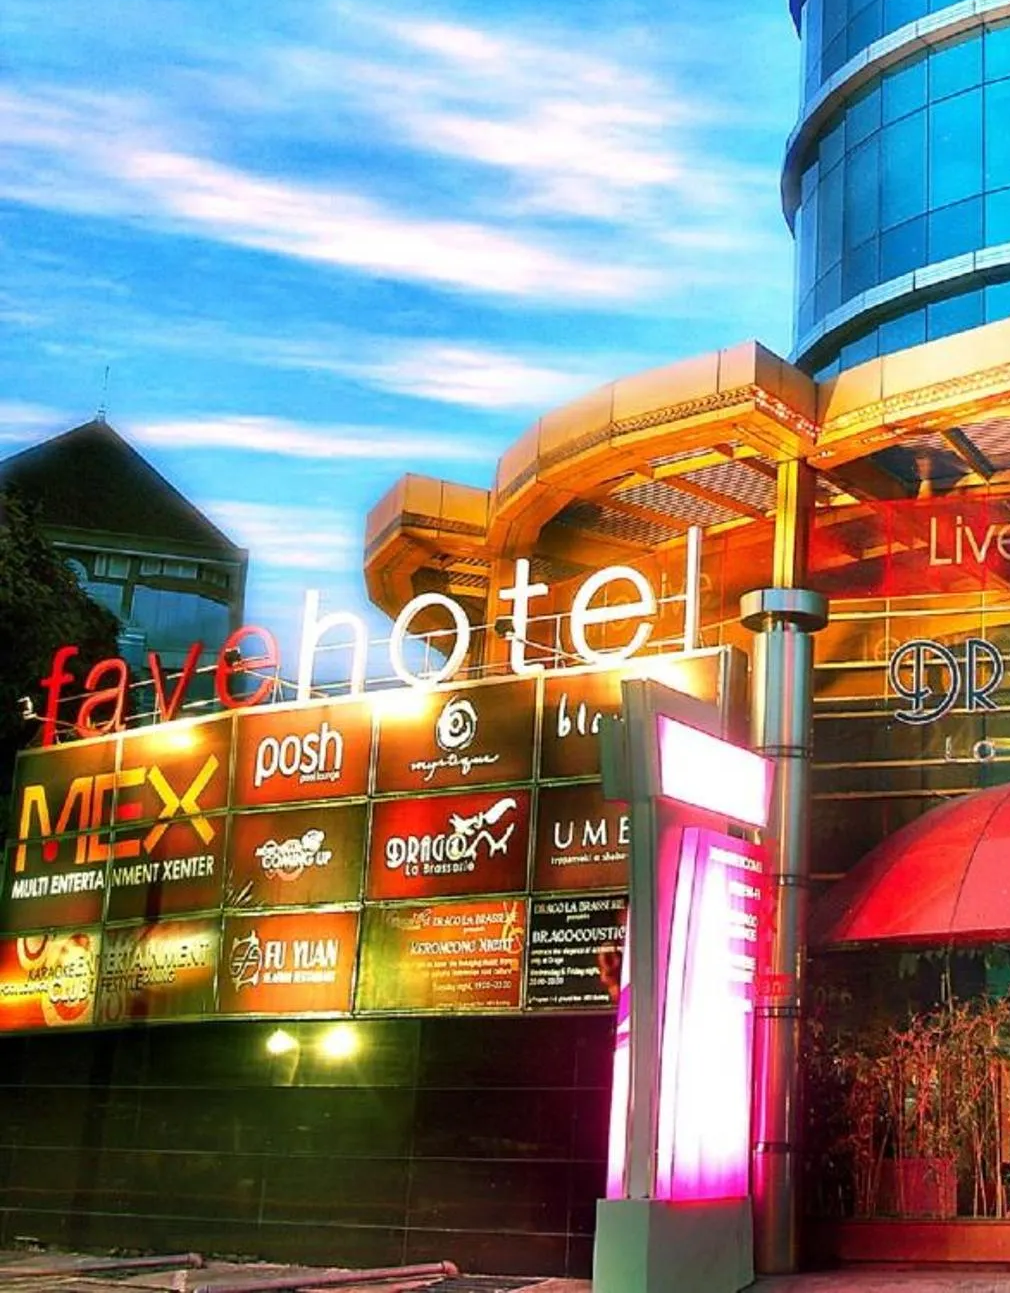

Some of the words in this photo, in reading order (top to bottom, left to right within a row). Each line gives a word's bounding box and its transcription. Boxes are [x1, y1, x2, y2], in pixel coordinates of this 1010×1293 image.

[254, 721, 343, 787] posh
[15, 753, 219, 873] MEX
[386, 832, 467, 869] DRAGO
[11, 876, 49, 899] MULTI
[162, 855, 215, 881] XENTER
[264, 940, 287, 970] FU
[292, 938, 339, 969] YUAN
